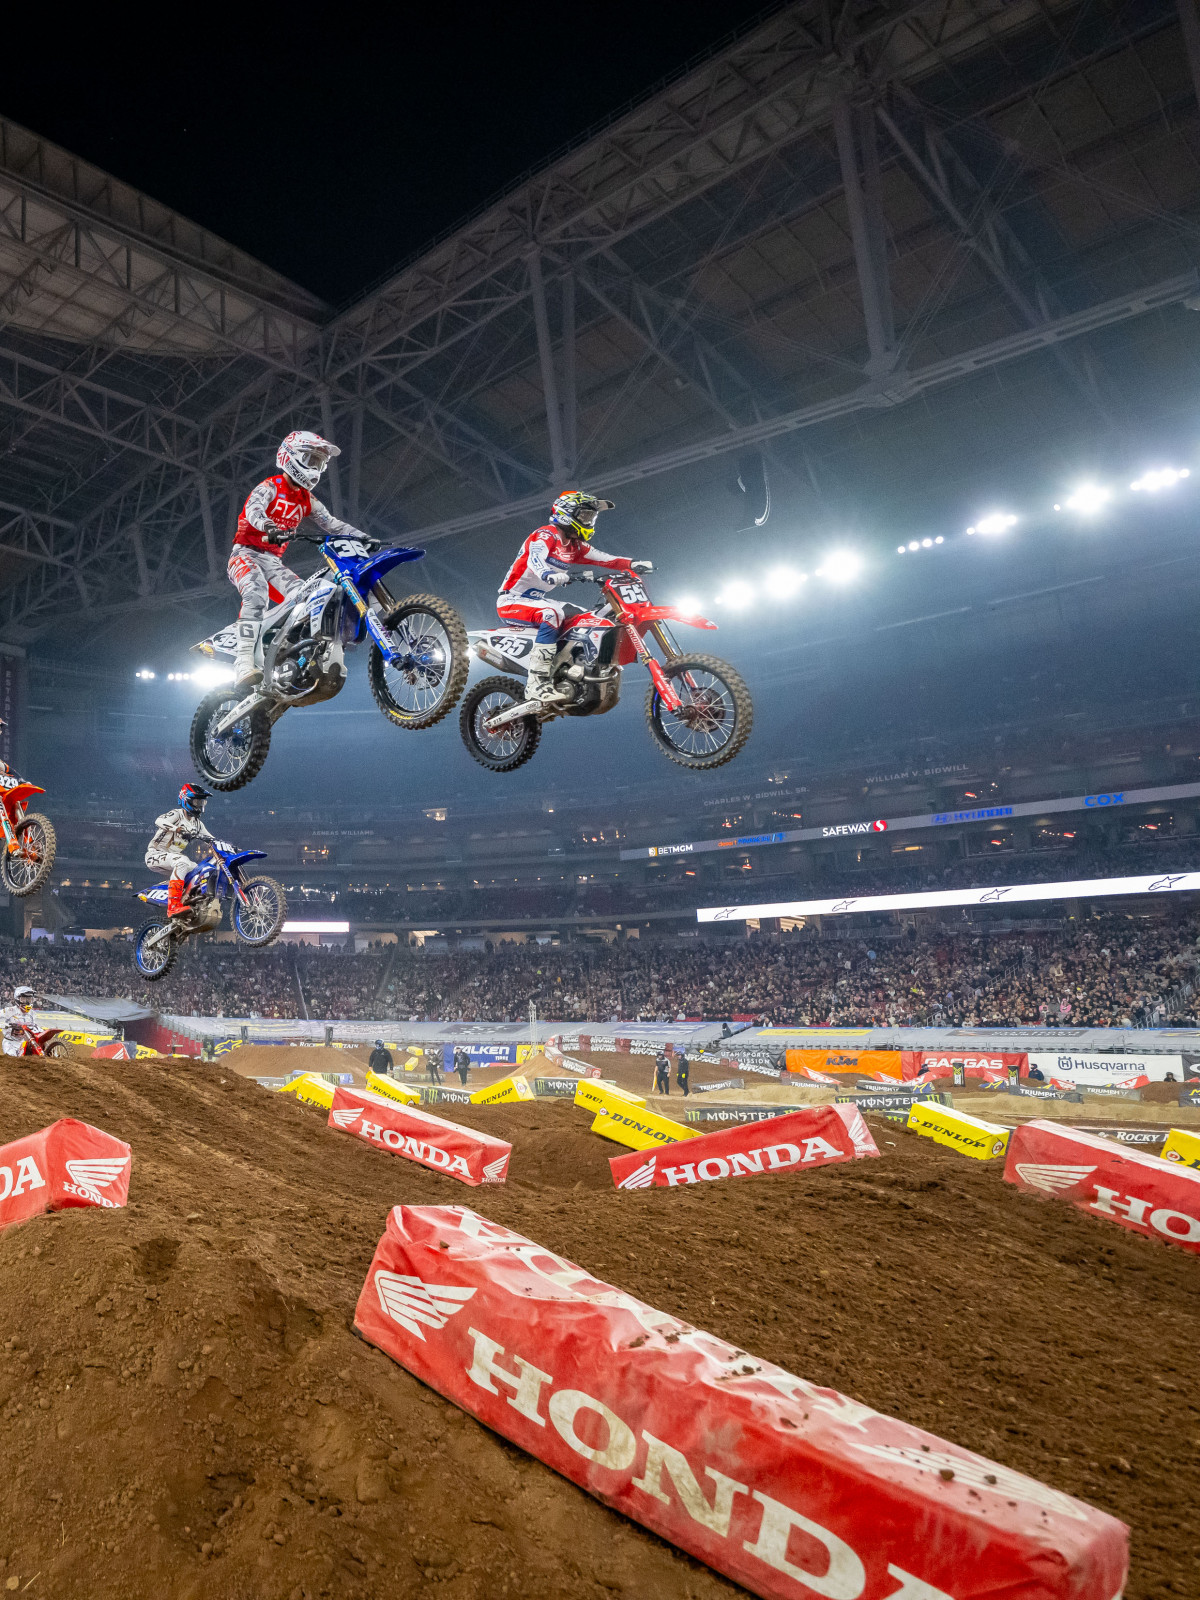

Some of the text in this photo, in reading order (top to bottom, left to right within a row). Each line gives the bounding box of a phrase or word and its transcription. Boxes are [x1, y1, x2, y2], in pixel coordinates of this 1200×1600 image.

[620, 585, 648, 604] 55
[494, 638, 527, 656] 55
[866, 771, 909, 784] WILLIAM
[924, 763, 969, 776] BIDWILL
[704, 797, 741, 807] CHARLES
[1085, 793, 1124, 807] COX
[953, 806, 1013, 822] HYUNDAI
[822, 822, 872, 837] SAFEWAY
[658, 844, 693, 855] BETMGM
[147, 889, 168, 901] 116
[453, 1045, 510, 1055] FALKEN
[825, 1055, 859, 1066] KTM
[1075, 1060, 1145, 1072] Husqvarna
[700, 1083, 726, 1091] TRIUMPH
[1019, 1088, 1056, 1098] TRIUMPH
[1086, 1087, 1120, 1095] TRIUMPH
[372, 1085, 402, 1104] DUNLOP
[855, 1097, 919, 1109] MONSTER
[707, 1111, 776, 1122] MONSTER
[921, 1121, 986, 1150] DUNLOP
[1117, 1131, 1160, 1142] ROCKY
[359, 1119, 474, 1180] HONDA
[661, 1136, 844, 1187] HONDA
